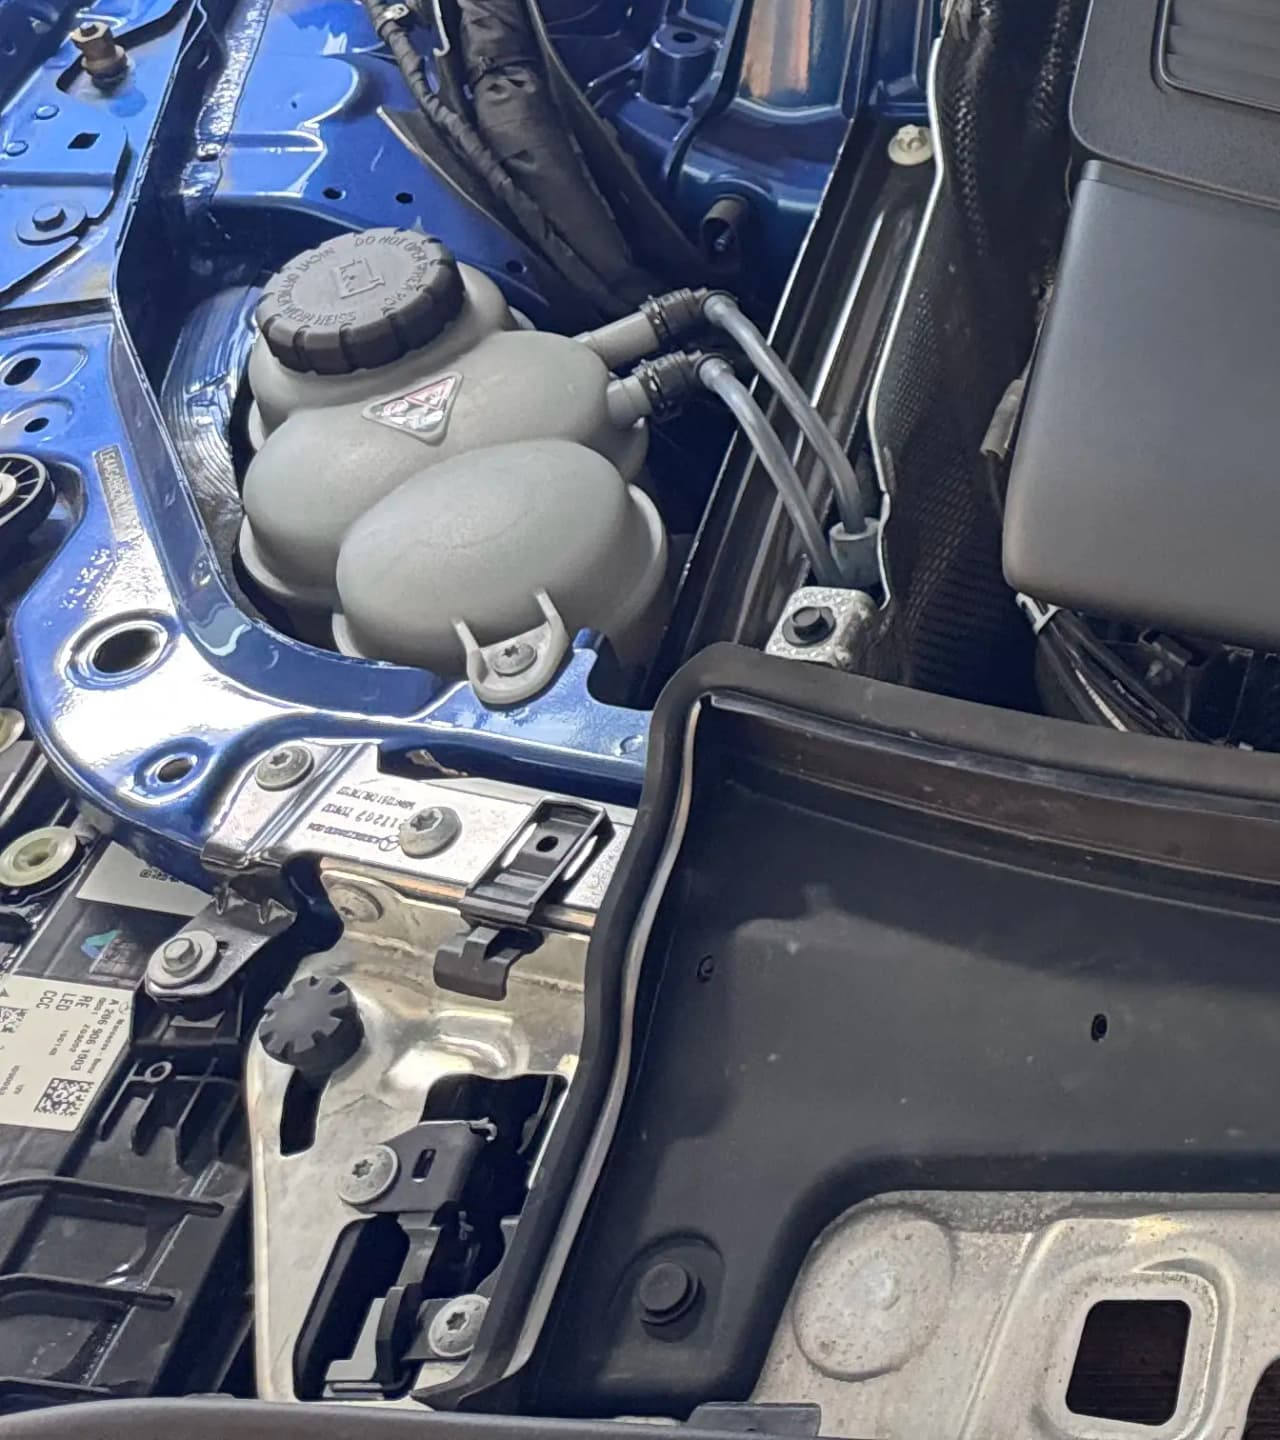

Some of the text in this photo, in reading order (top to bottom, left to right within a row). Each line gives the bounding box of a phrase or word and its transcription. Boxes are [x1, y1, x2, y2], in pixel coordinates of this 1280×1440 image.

[313, 312, 357, 326] HEISS
[36, 990, 58, 1010] CCC
[55, 993, 77, 1011] LED
[75, 995, 93, 1009] RE
[108, 998, 119, 1006] A
[97, 1008, 115, 1026] 206
[86, 1028, 103, 1045] 906
